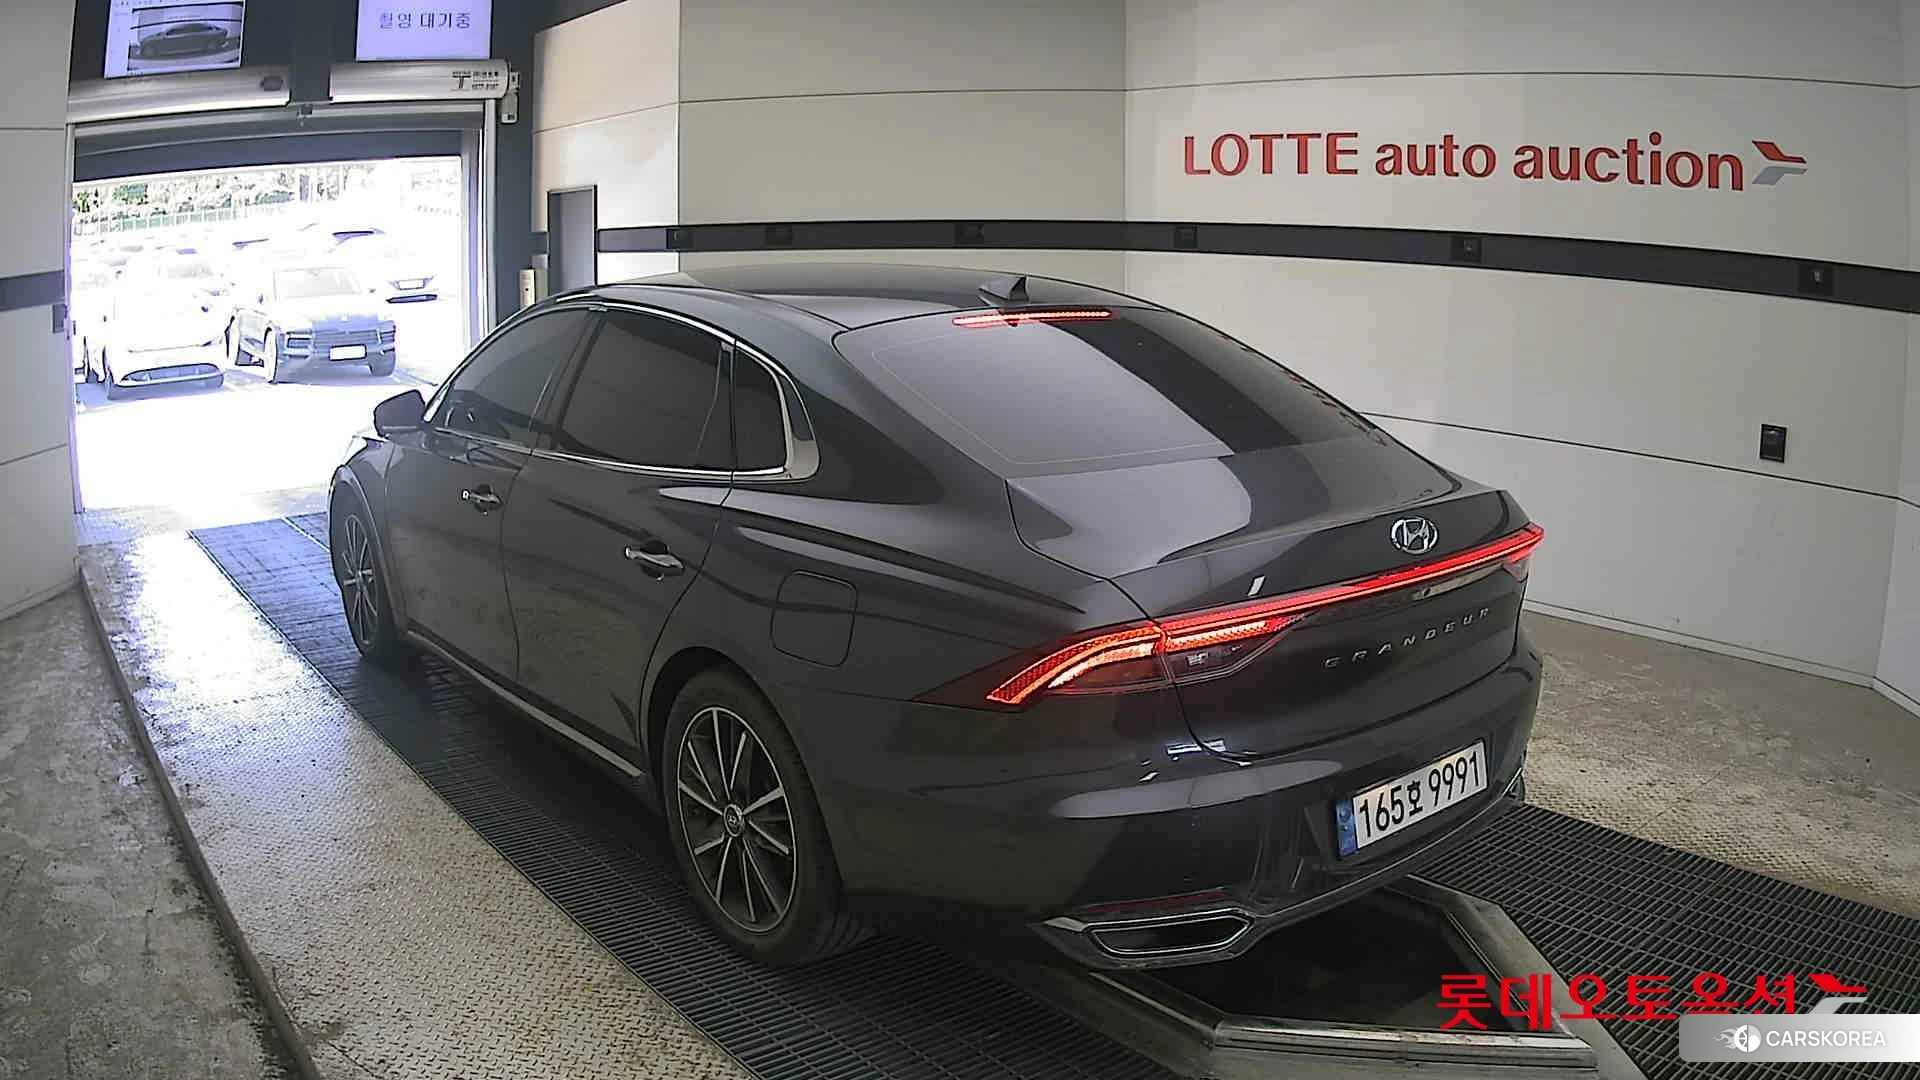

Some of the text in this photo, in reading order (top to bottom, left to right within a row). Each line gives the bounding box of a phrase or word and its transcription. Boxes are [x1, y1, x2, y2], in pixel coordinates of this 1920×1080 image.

[420, 12, 471, 29] 대기중
[1184, 131, 1744, 191] LOTTE auto auction
[1323, 606, 1491, 669] GRANDEUR
[1359, 751, 1480, 838] 165호 9991
